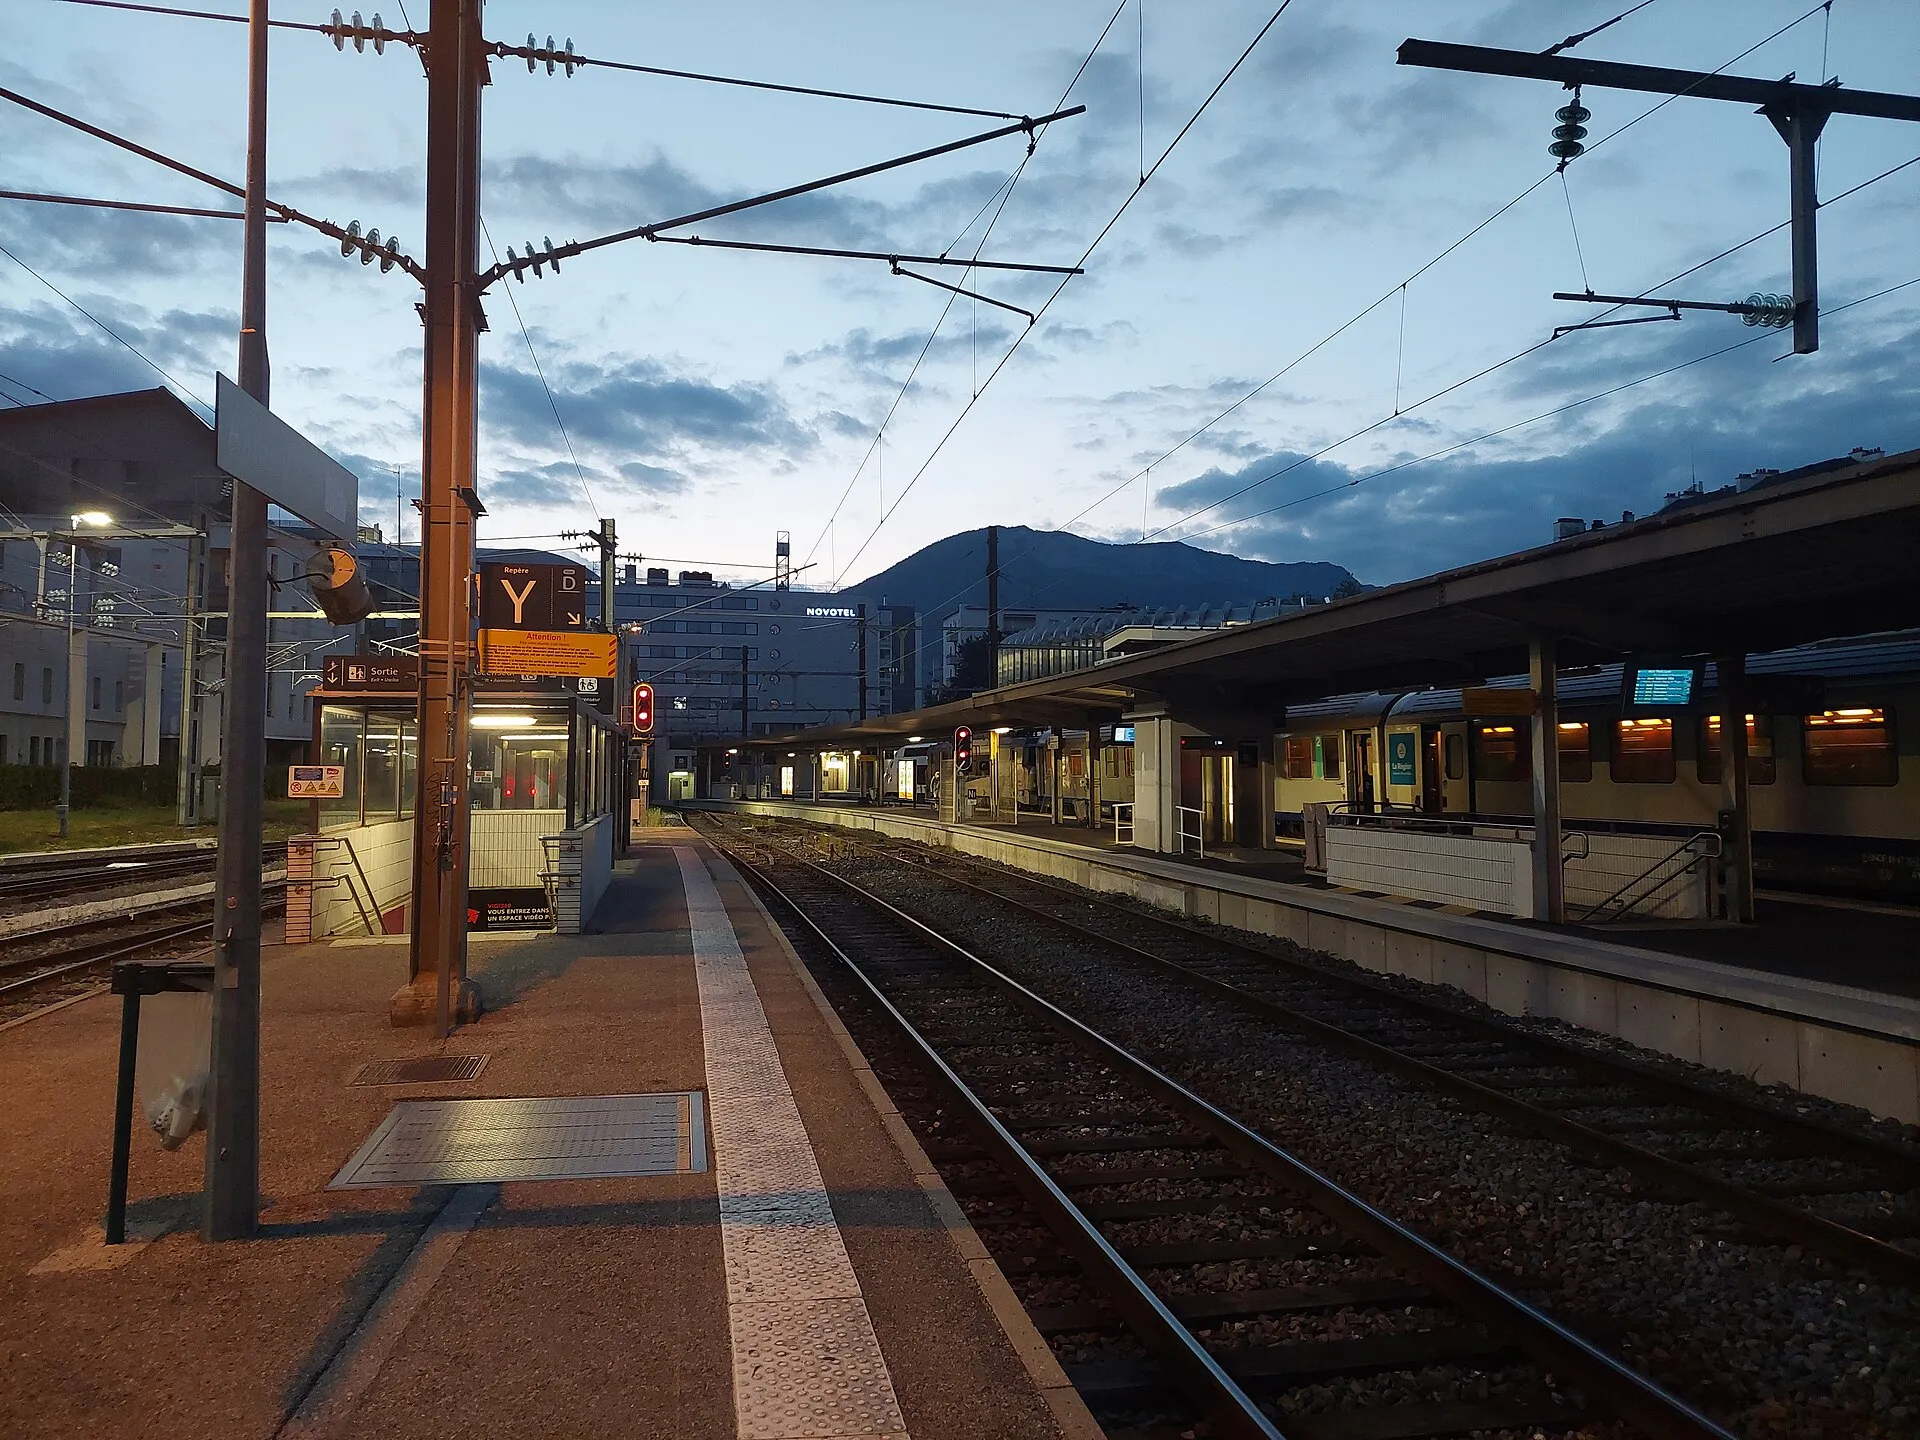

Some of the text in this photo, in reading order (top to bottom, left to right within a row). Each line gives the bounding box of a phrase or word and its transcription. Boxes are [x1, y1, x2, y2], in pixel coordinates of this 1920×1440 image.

[504, 566, 529, 575] Repère
[563, 576, 576, 590] D
[500, 579, 537, 624] Y
[806, 607, 856, 617] NOVOTEL
[526, 633, 561, 641] Attention
[371, 667, 398, 675] Sortie
[1315, 736, 1321, 747] 2
